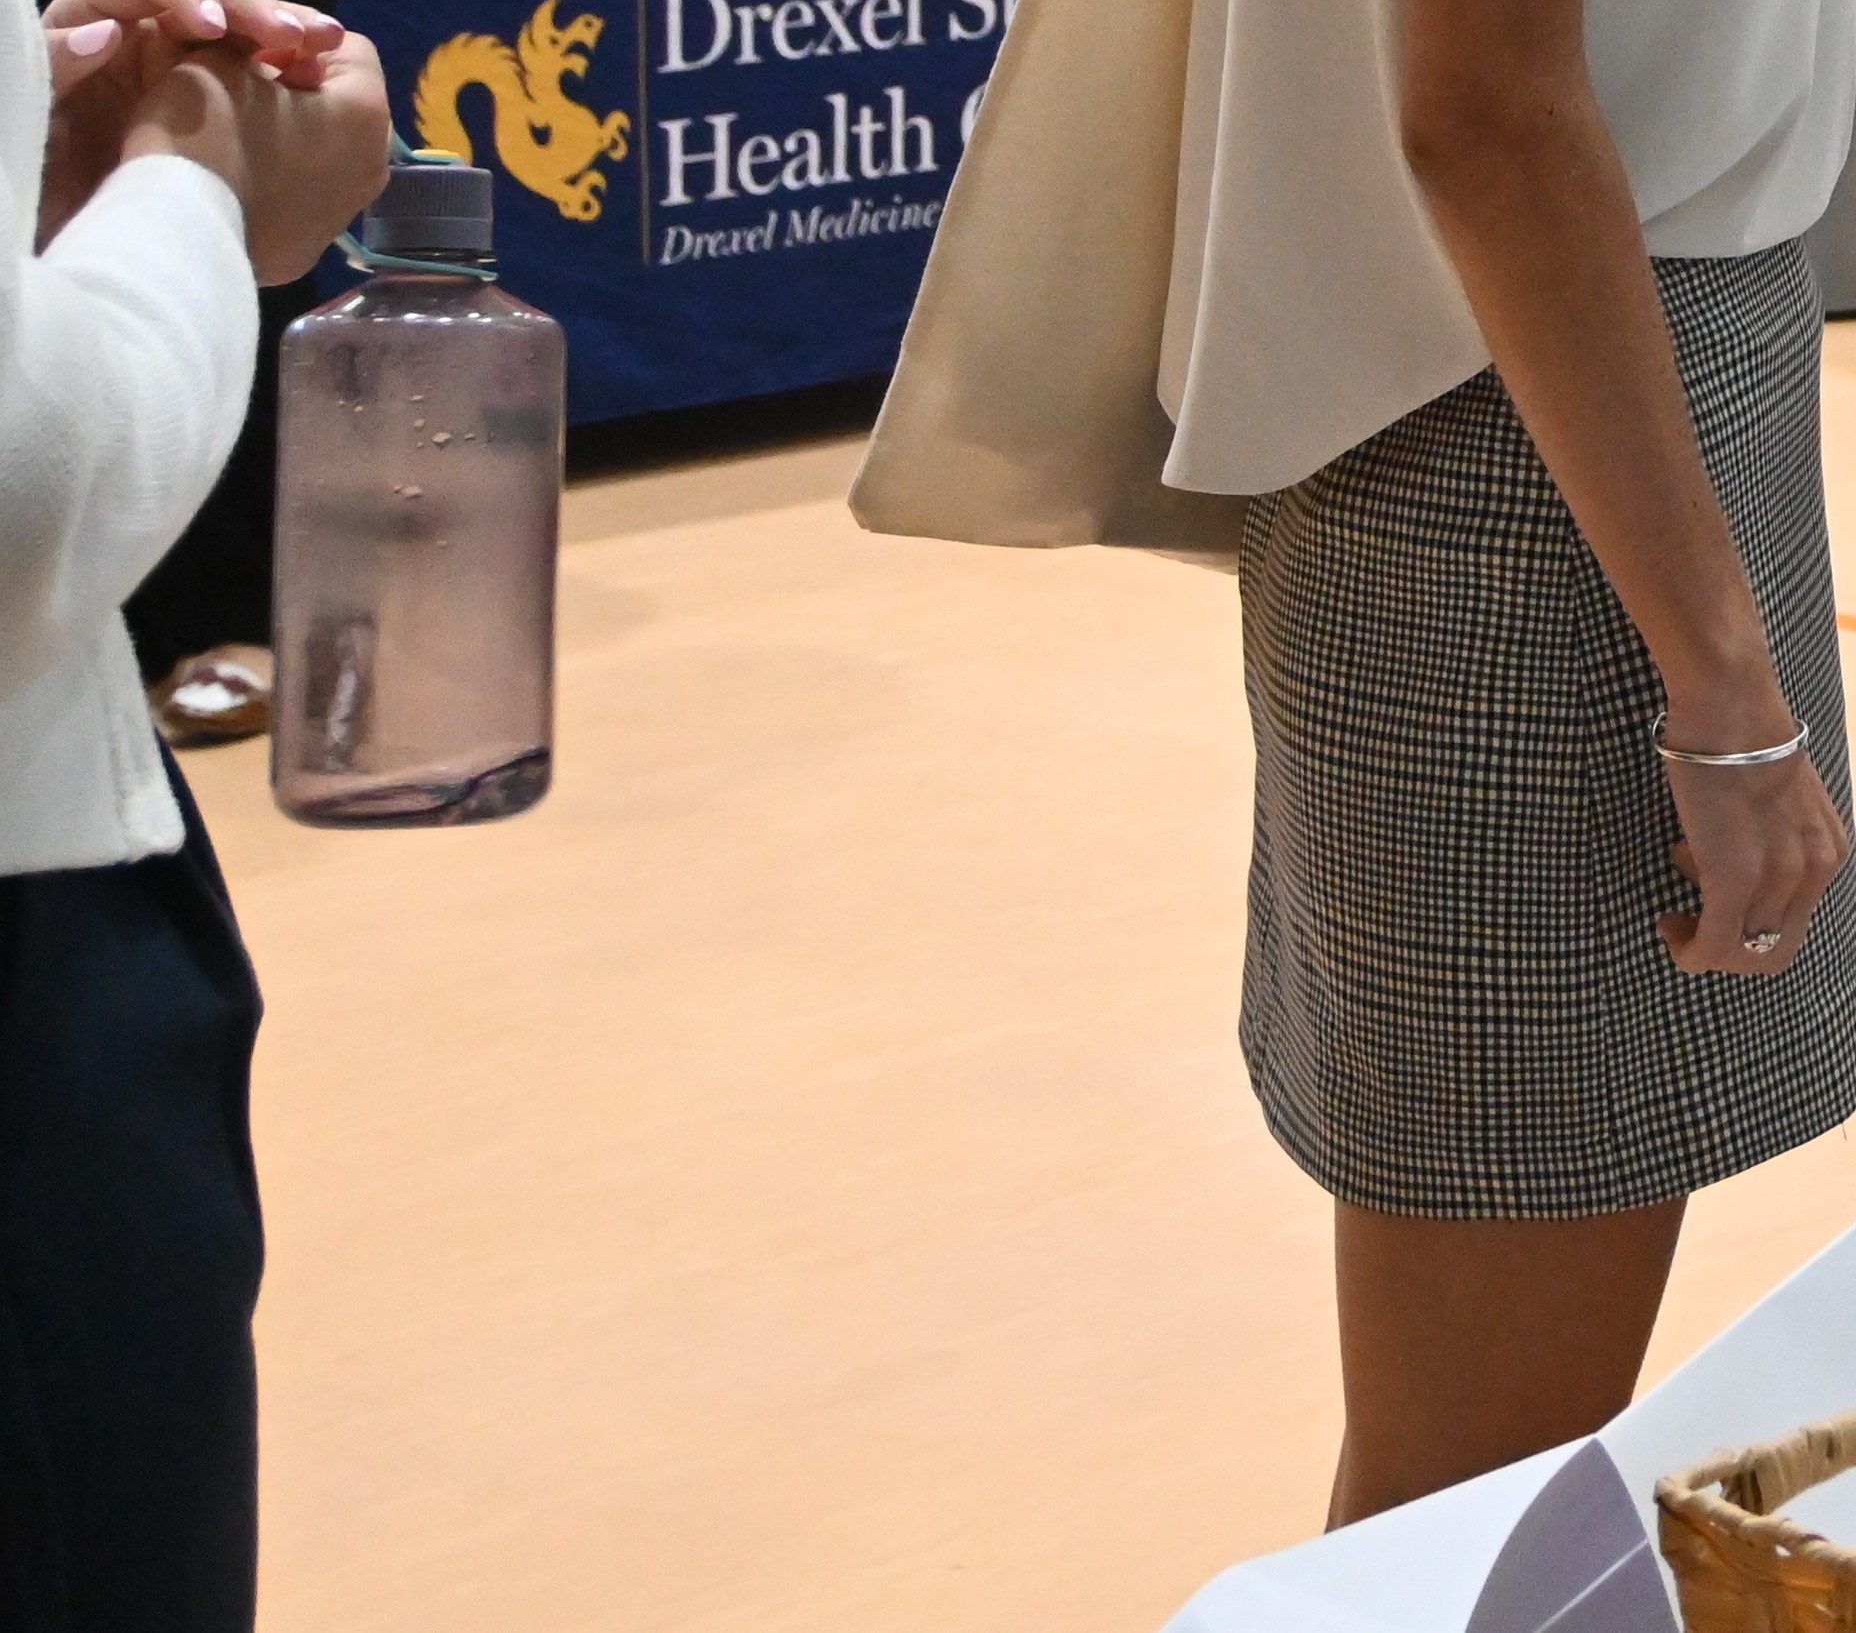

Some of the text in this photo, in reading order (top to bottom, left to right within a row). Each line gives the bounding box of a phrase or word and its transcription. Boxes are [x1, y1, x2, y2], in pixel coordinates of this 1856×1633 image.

[658, 85, 940, 207] Health
[659, 195, 943, 266] Drexel Medicine
